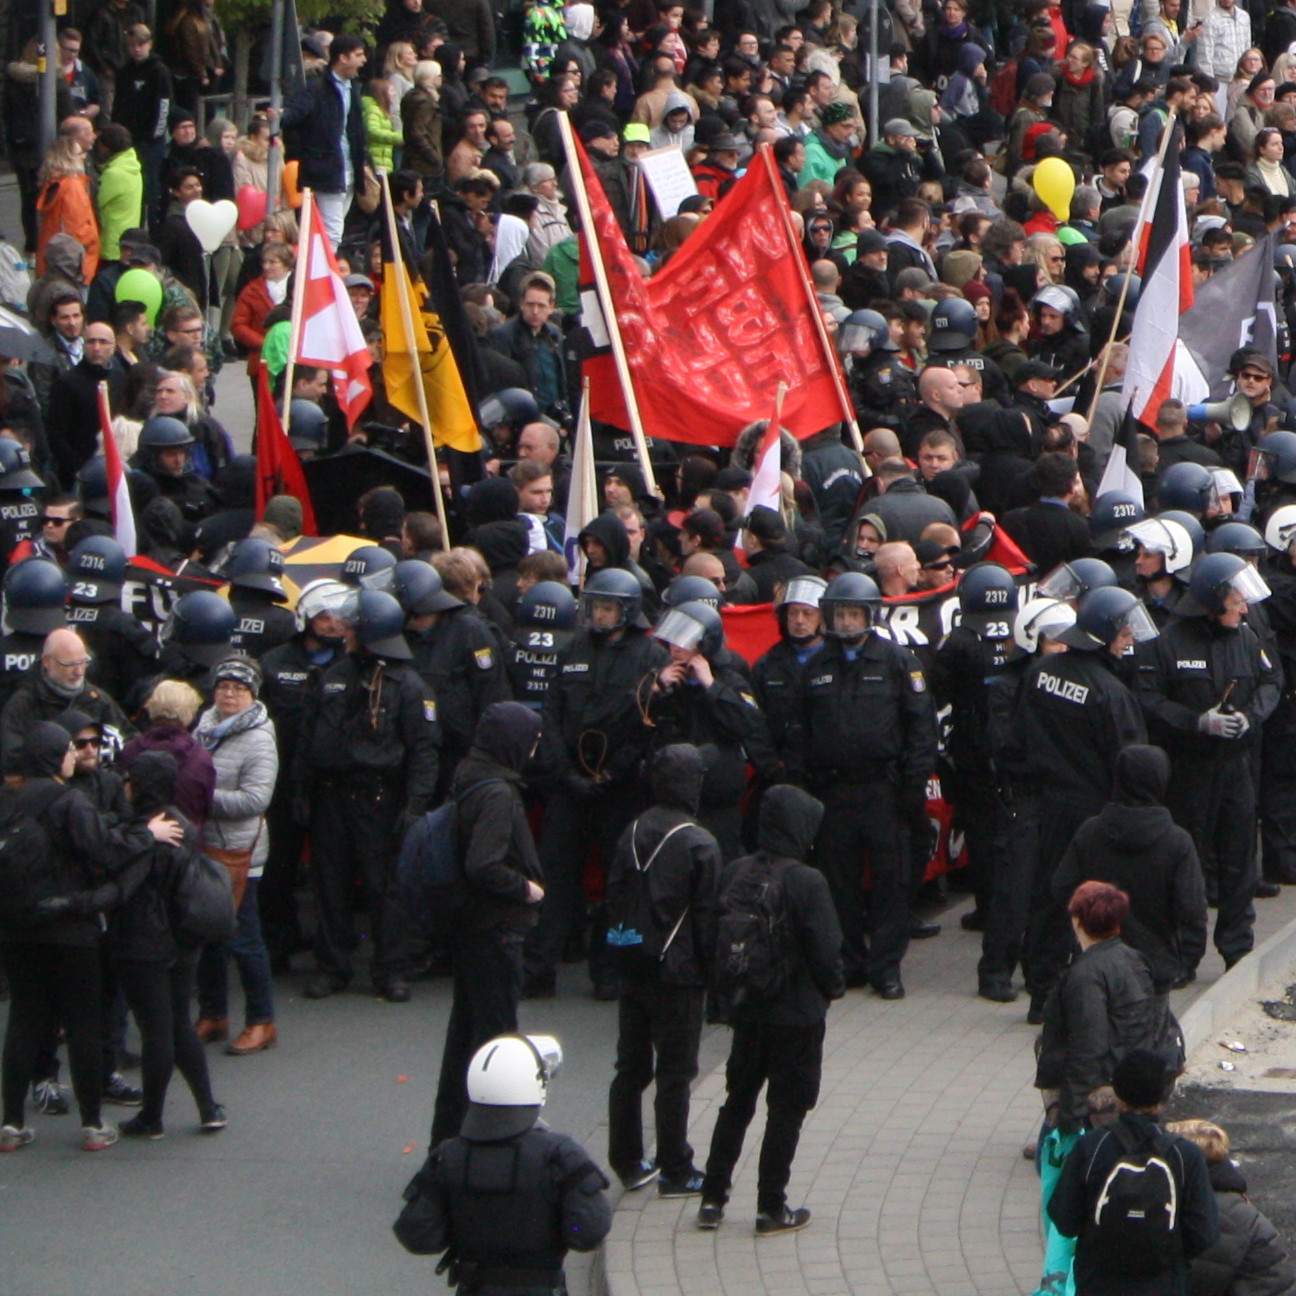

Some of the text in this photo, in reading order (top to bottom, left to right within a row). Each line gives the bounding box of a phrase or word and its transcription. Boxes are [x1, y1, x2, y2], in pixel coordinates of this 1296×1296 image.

[1, 504, 38, 520] POLIZEI
[1113, 505, 1136, 518] 2312
[81, 555, 106, 570] 2314
[72, 582, 98, 597] 23
[985, 590, 1008, 603] 2312
[533, 605, 555, 620] 2311
[986, 622, 1009, 636] 23
[529, 632, 554, 647] 23
[562, 663, 588, 673] POLIZEI
[1176, 660, 1206, 669] POLIZEI
[533, 668, 545, 677] HE
[1037, 671, 1089, 704] POLIZEI
